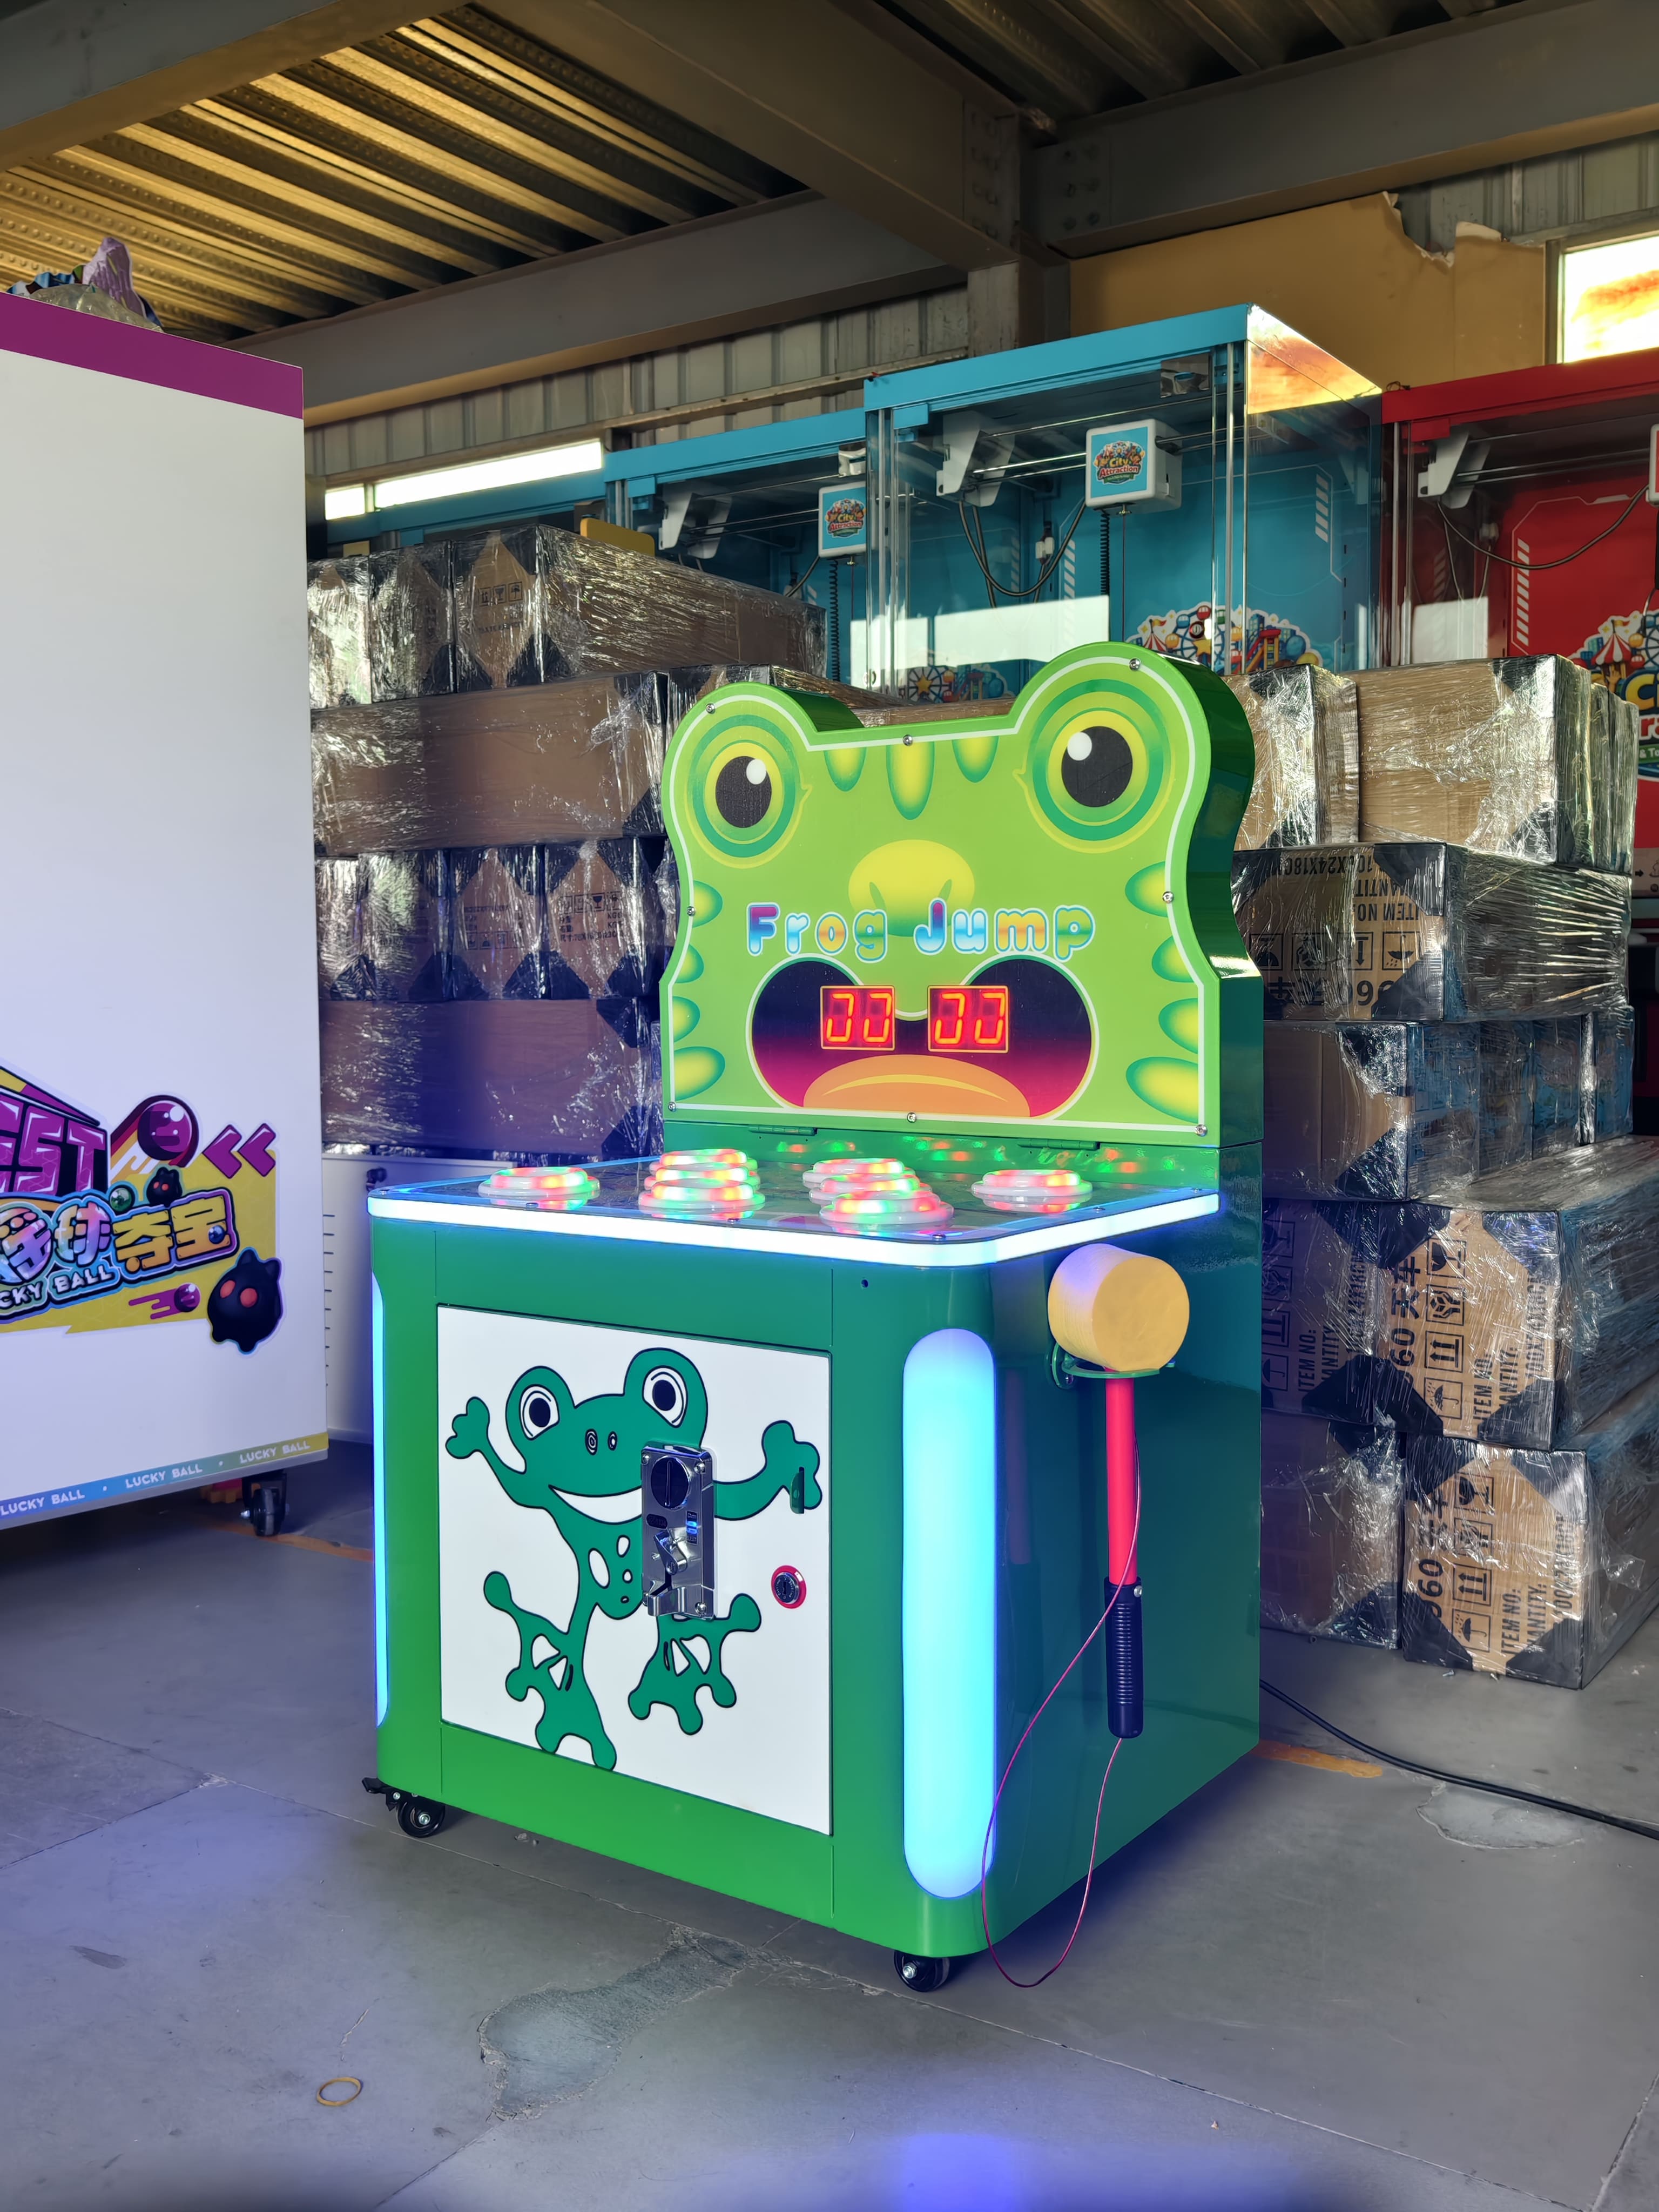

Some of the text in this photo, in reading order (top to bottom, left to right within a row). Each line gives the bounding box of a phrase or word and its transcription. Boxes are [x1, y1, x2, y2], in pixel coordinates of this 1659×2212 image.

[1100, 466, 1138, 478] Attraction
[1109, 457, 1129, 467] City
[1383, 903, 1419, 921] ITEM
[747, 898, 1095, 963] Frog Jump
[54, 1265, 113, 1293] BALL
[1298, 1330, 1317, 1392] ITEM NO:
[1473, 1385, 1492, 1420] ITEM
[0, 1440, 311, 1516] LUCKY BALL LUCKY BALL LUCKY BALL
[1501, 1589, 1521, 1655] ITEM NO:
